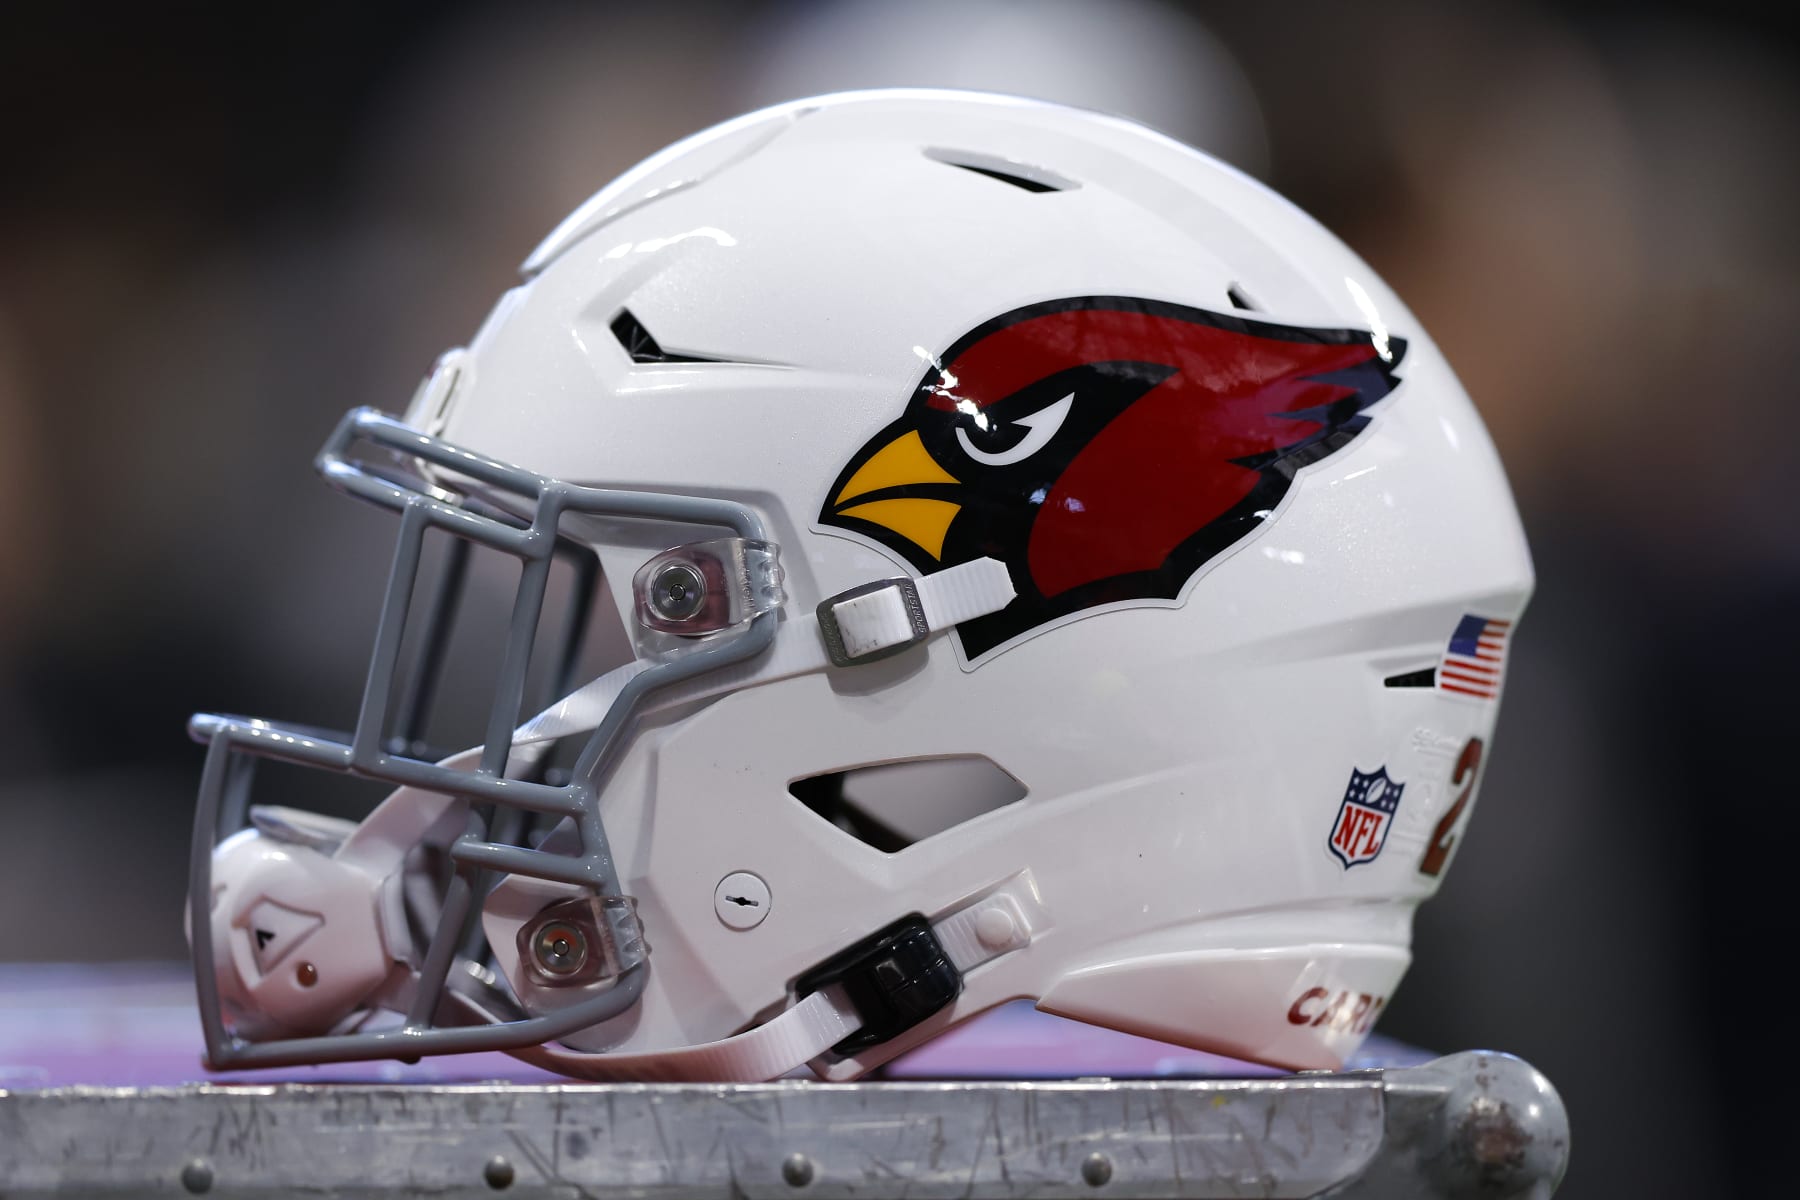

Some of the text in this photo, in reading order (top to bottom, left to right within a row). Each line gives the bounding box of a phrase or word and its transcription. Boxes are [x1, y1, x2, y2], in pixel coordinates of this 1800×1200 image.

[904, 583, 927, 633] SPORTSTAR
[1333, 804, 1384, 858] NFL
[1419, 736, 1484, 877] 2
